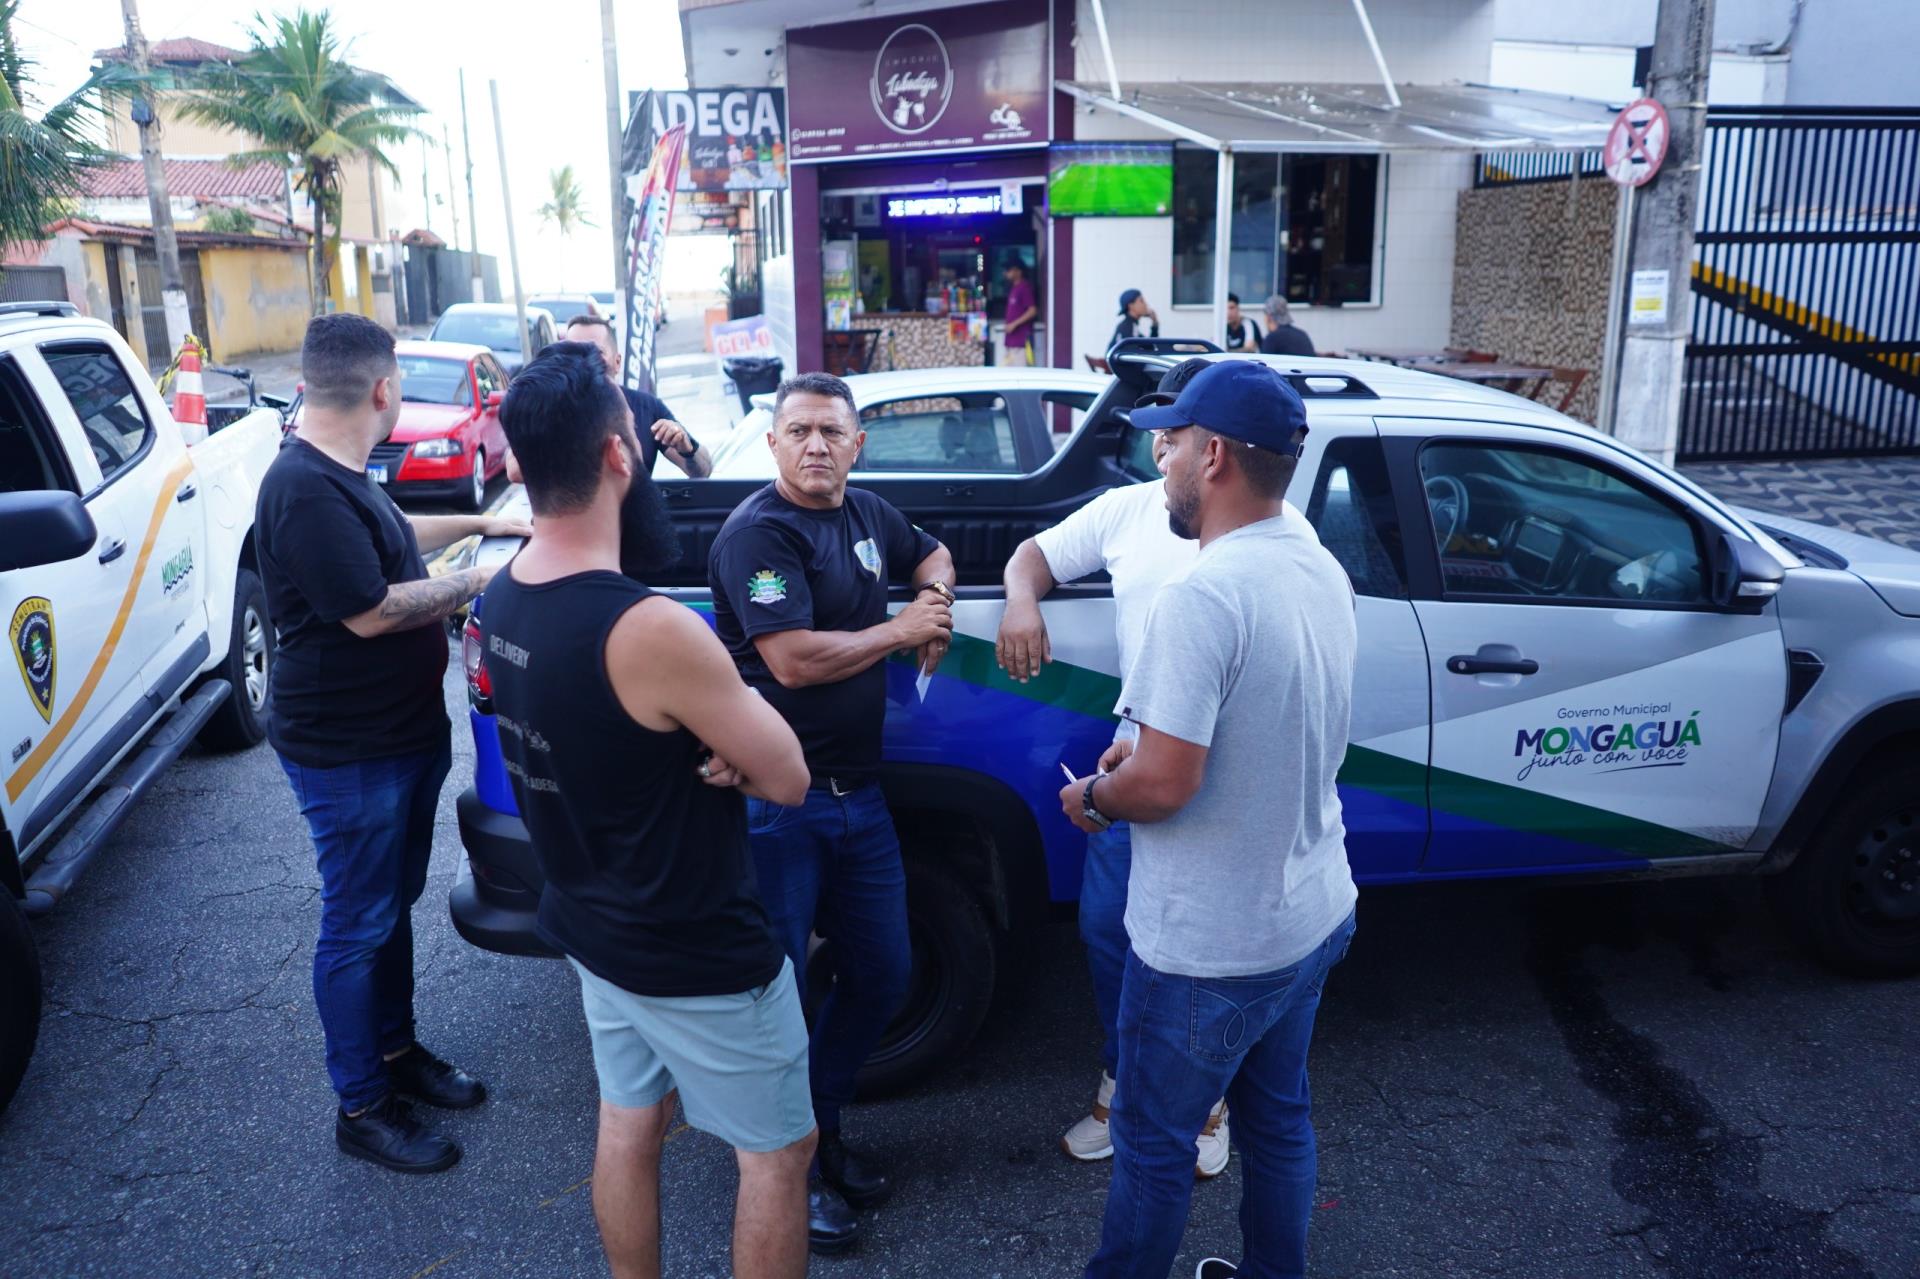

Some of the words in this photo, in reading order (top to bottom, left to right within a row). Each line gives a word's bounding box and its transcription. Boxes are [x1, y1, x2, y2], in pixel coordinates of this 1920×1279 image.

[489, 634, 531, 669] DELIVERY
[1557, 707, 1610, 719] Governo
[1613, 702, 1671, 717] Municipal
[1514, 710, 1701, 757] MONGAGUÁ
[1517, 746, 1587, 782] junto
[1593, 750, 1636, 765] com
[1641, 743, 1689, 761] você
